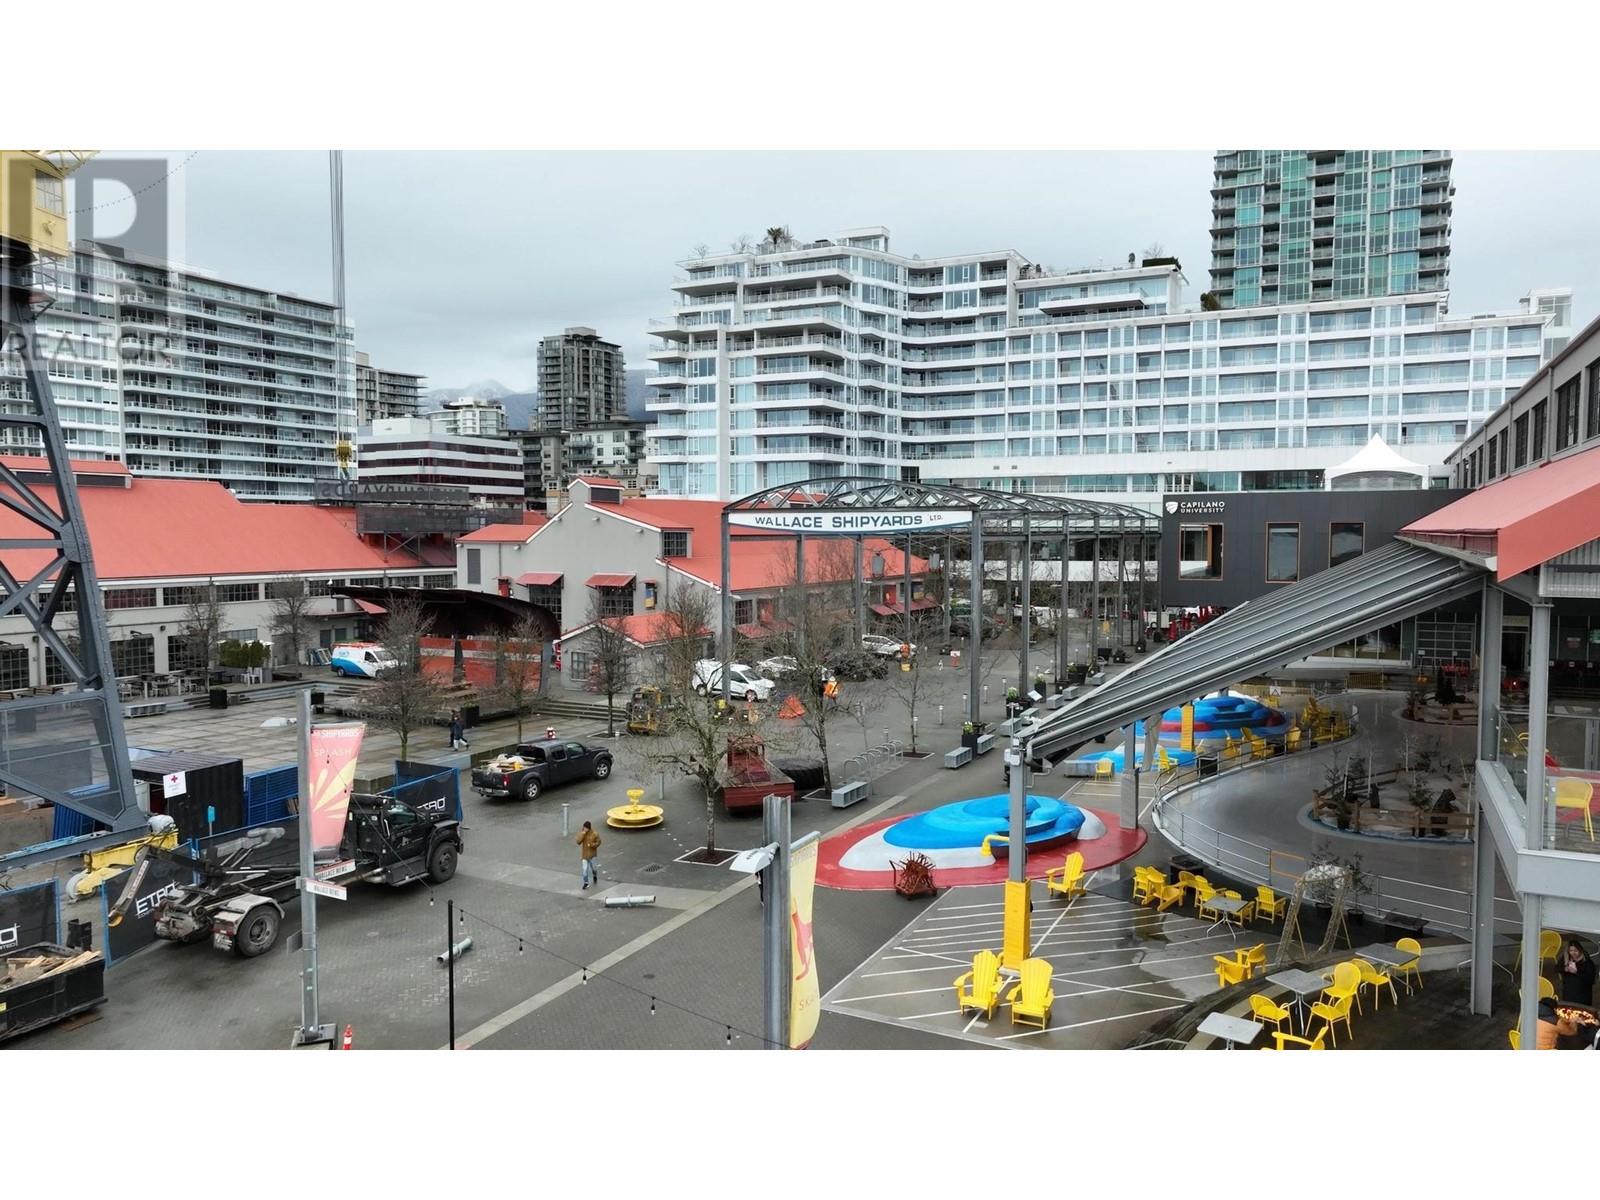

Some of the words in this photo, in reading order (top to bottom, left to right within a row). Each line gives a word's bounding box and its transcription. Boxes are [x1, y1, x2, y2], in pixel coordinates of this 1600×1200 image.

[754, 515, 824, 529] WALLACE
[831, 515, 924, 529] SHIPYARDS
[928, 513, 944, 522] LTD.
[416, 797, 447, 811] TRO
